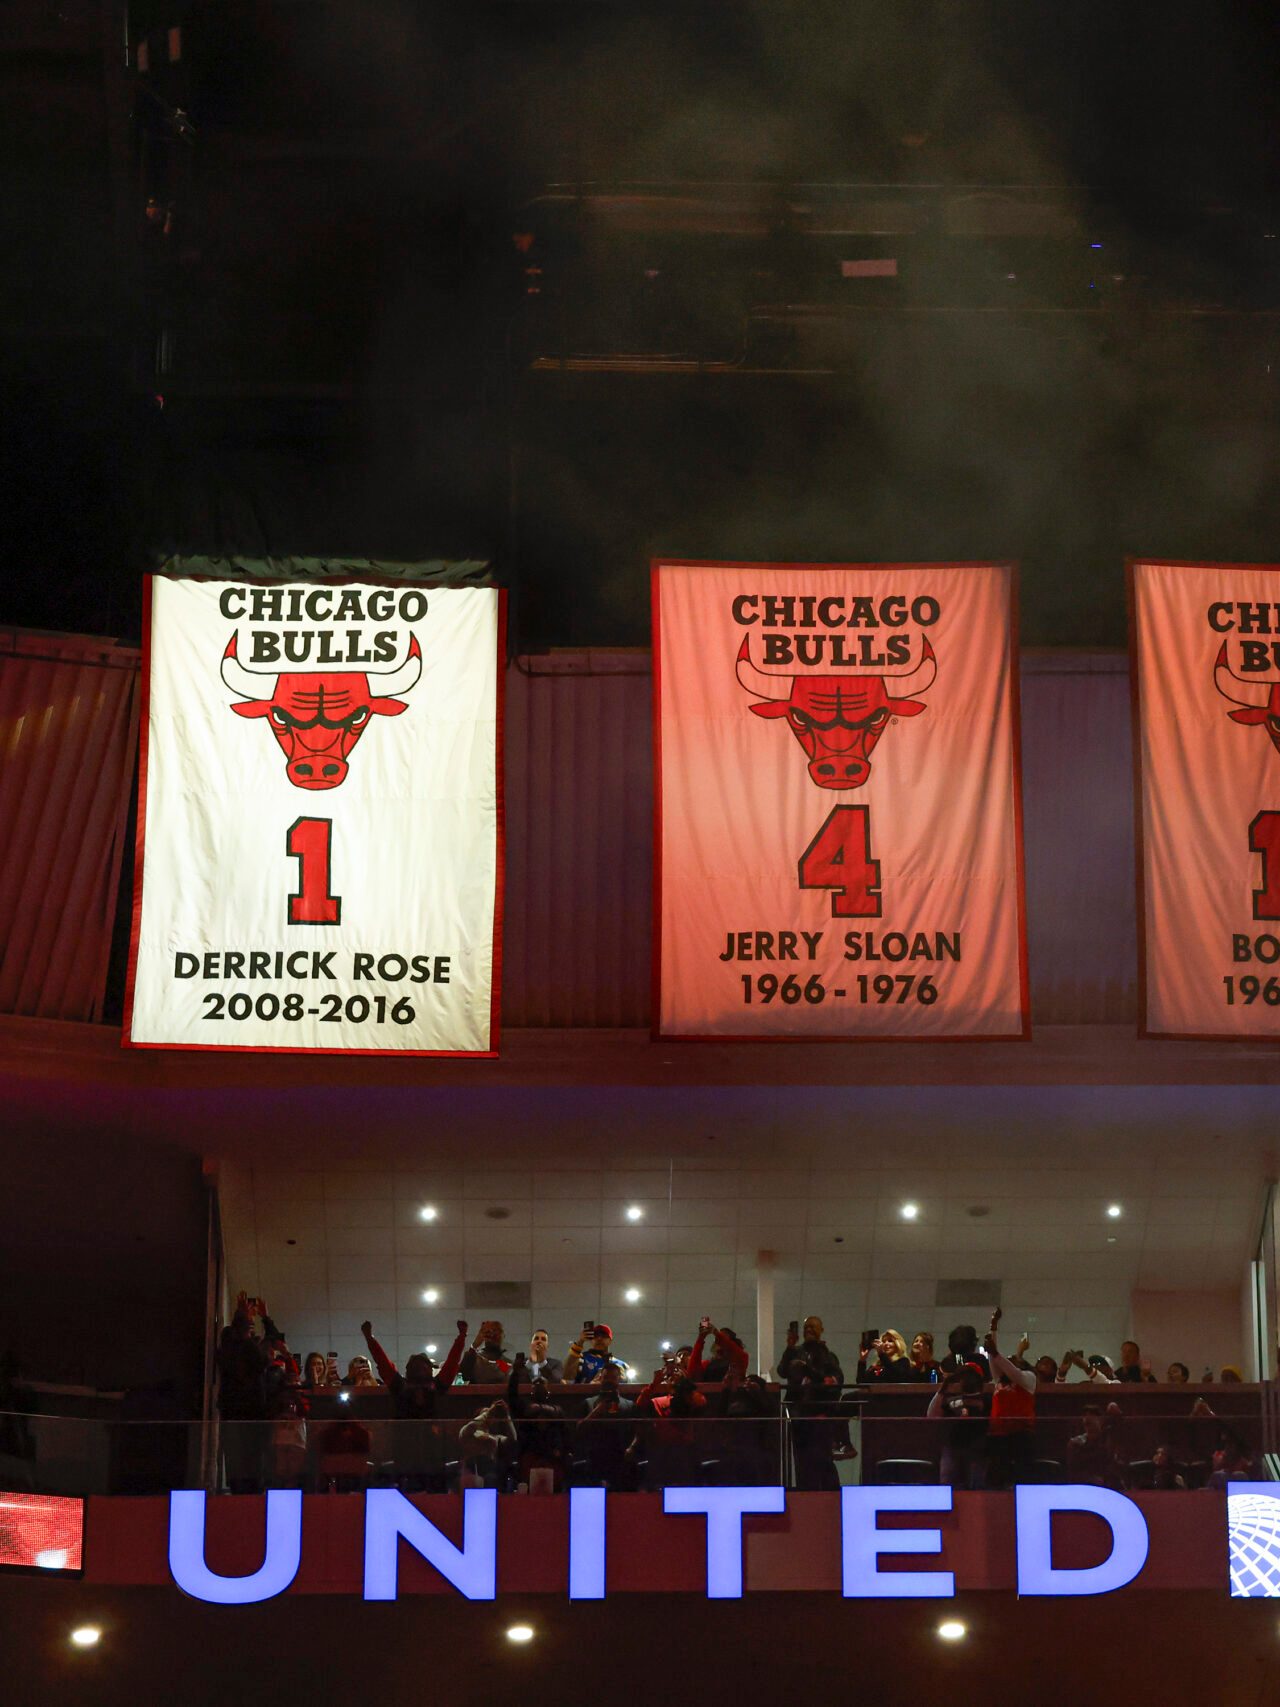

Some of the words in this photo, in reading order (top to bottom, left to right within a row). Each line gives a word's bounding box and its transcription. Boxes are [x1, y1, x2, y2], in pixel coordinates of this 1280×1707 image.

[220, 587, 428, 622] CHICAGO
[732, 595, 940, 627] CHICAGO
[250, 630, 397, 663] BULLS
[762, 634, 910, 666] BULLS
[286, 816, 341, 926] 1
[798, 804, 882, 918] 4
[720, 931, 823, 961] JERRY
[844, 932, 961, 962] SLOAN
[175, 951, 337, 979] DERRICK
[354, 953, 450, 983] ROSE
[202, 993, 415, 1025] 2008-2016
[169, 1485, 1148, 1604] UNITED
